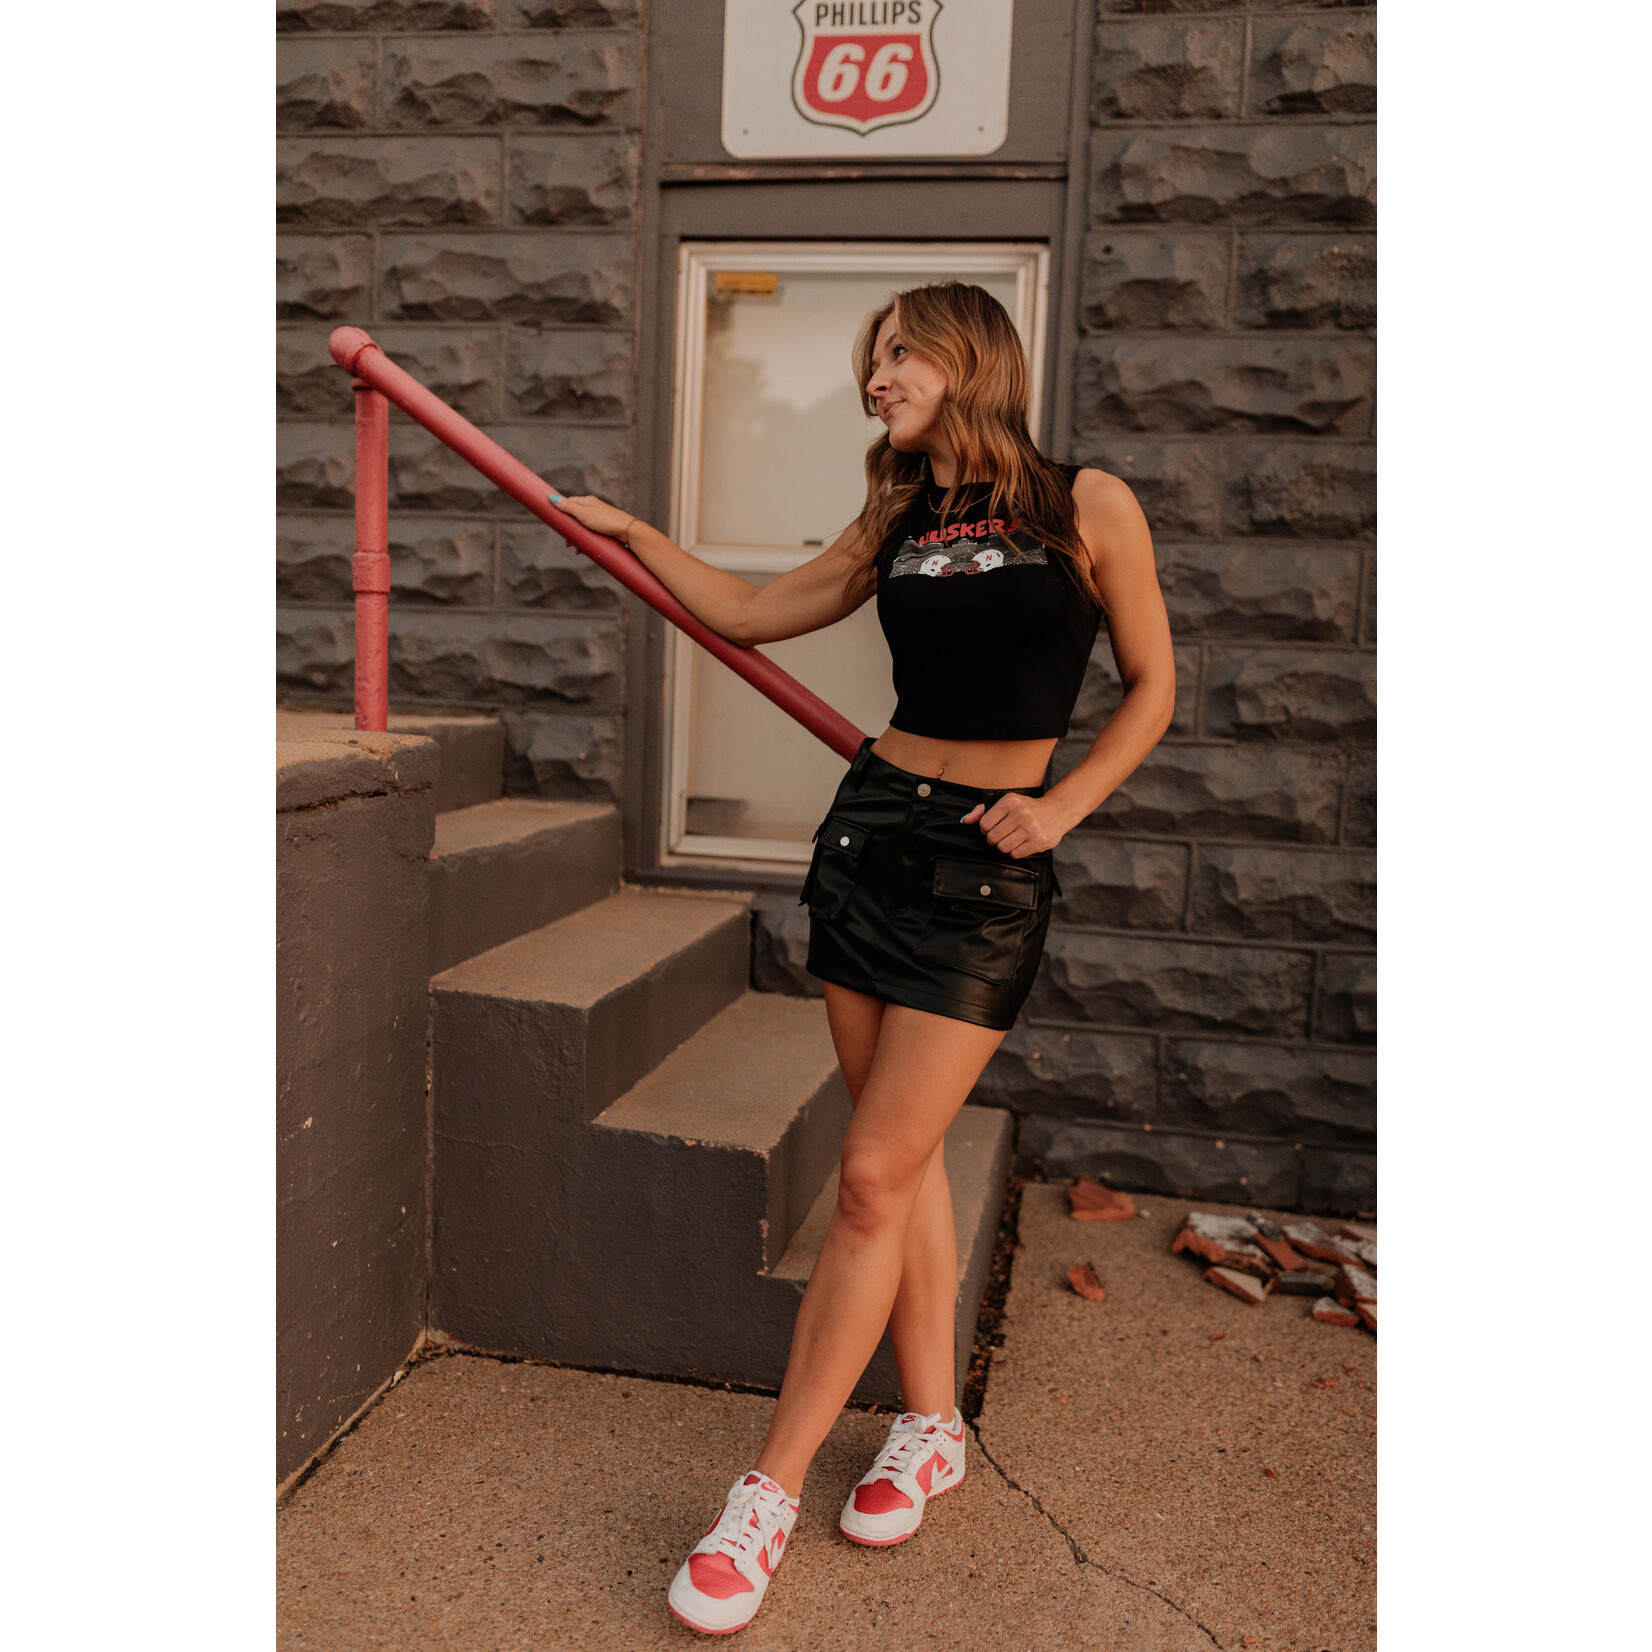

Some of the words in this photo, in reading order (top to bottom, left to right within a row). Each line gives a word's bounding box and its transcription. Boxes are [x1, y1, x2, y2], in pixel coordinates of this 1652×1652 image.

[816, 0, 922, 27] PHILLIPS
[817, 42, 914, 103] 66
[931, 559, 939, 567] N
[985, 554, 993, 562] N
